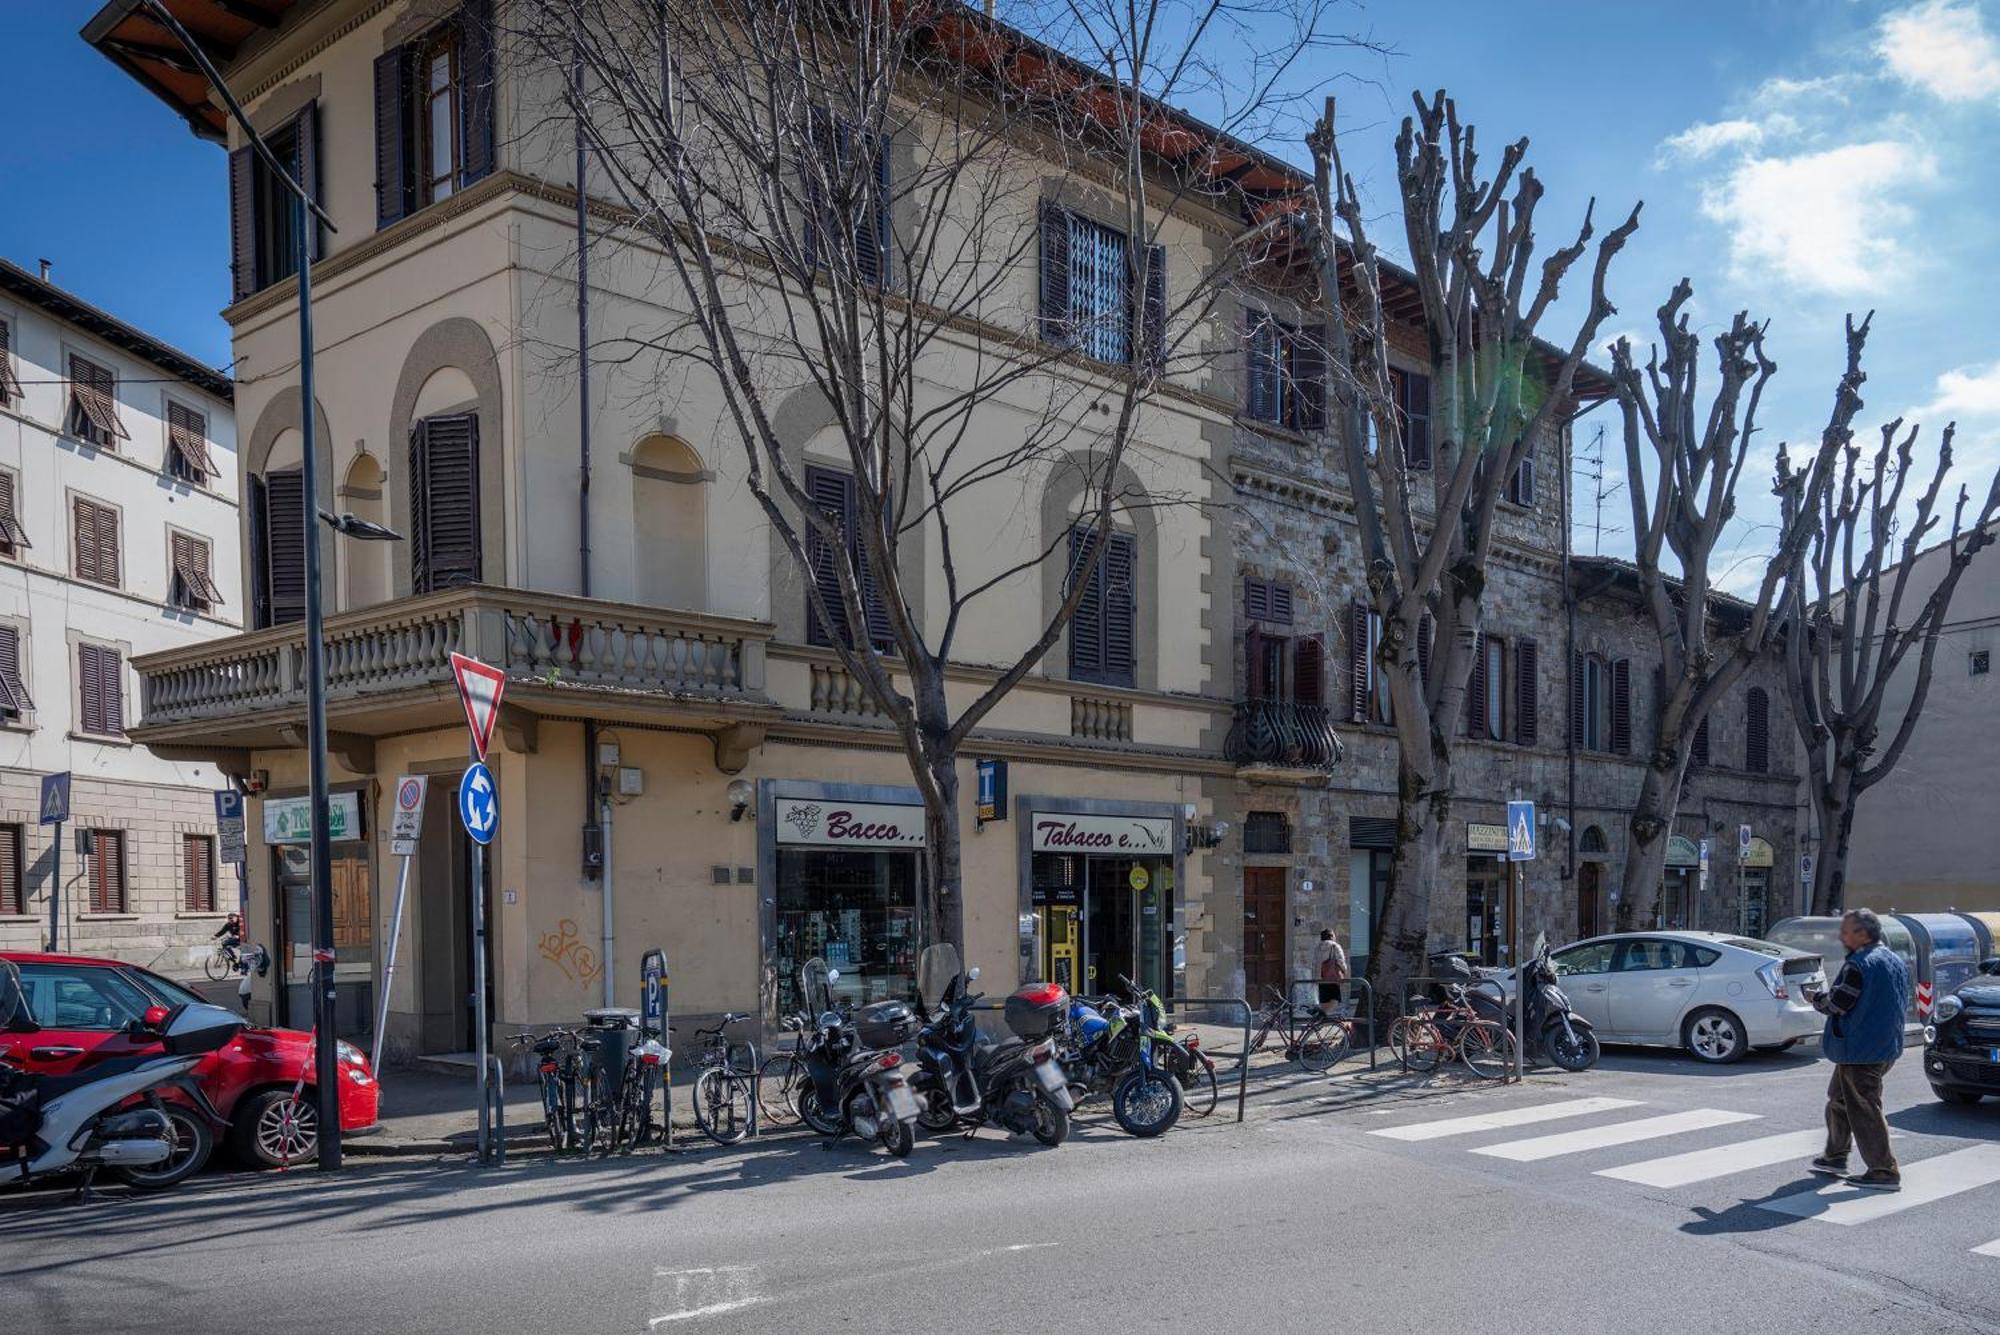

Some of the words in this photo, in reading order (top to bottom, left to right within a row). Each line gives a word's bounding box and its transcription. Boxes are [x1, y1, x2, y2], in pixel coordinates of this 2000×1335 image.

[980, 767, 995, 803] T
[219, 792, 237, 816] P
[826, 810, 924, 841] Bacco...
[1036, 820, 1114, 848] Tabacco
